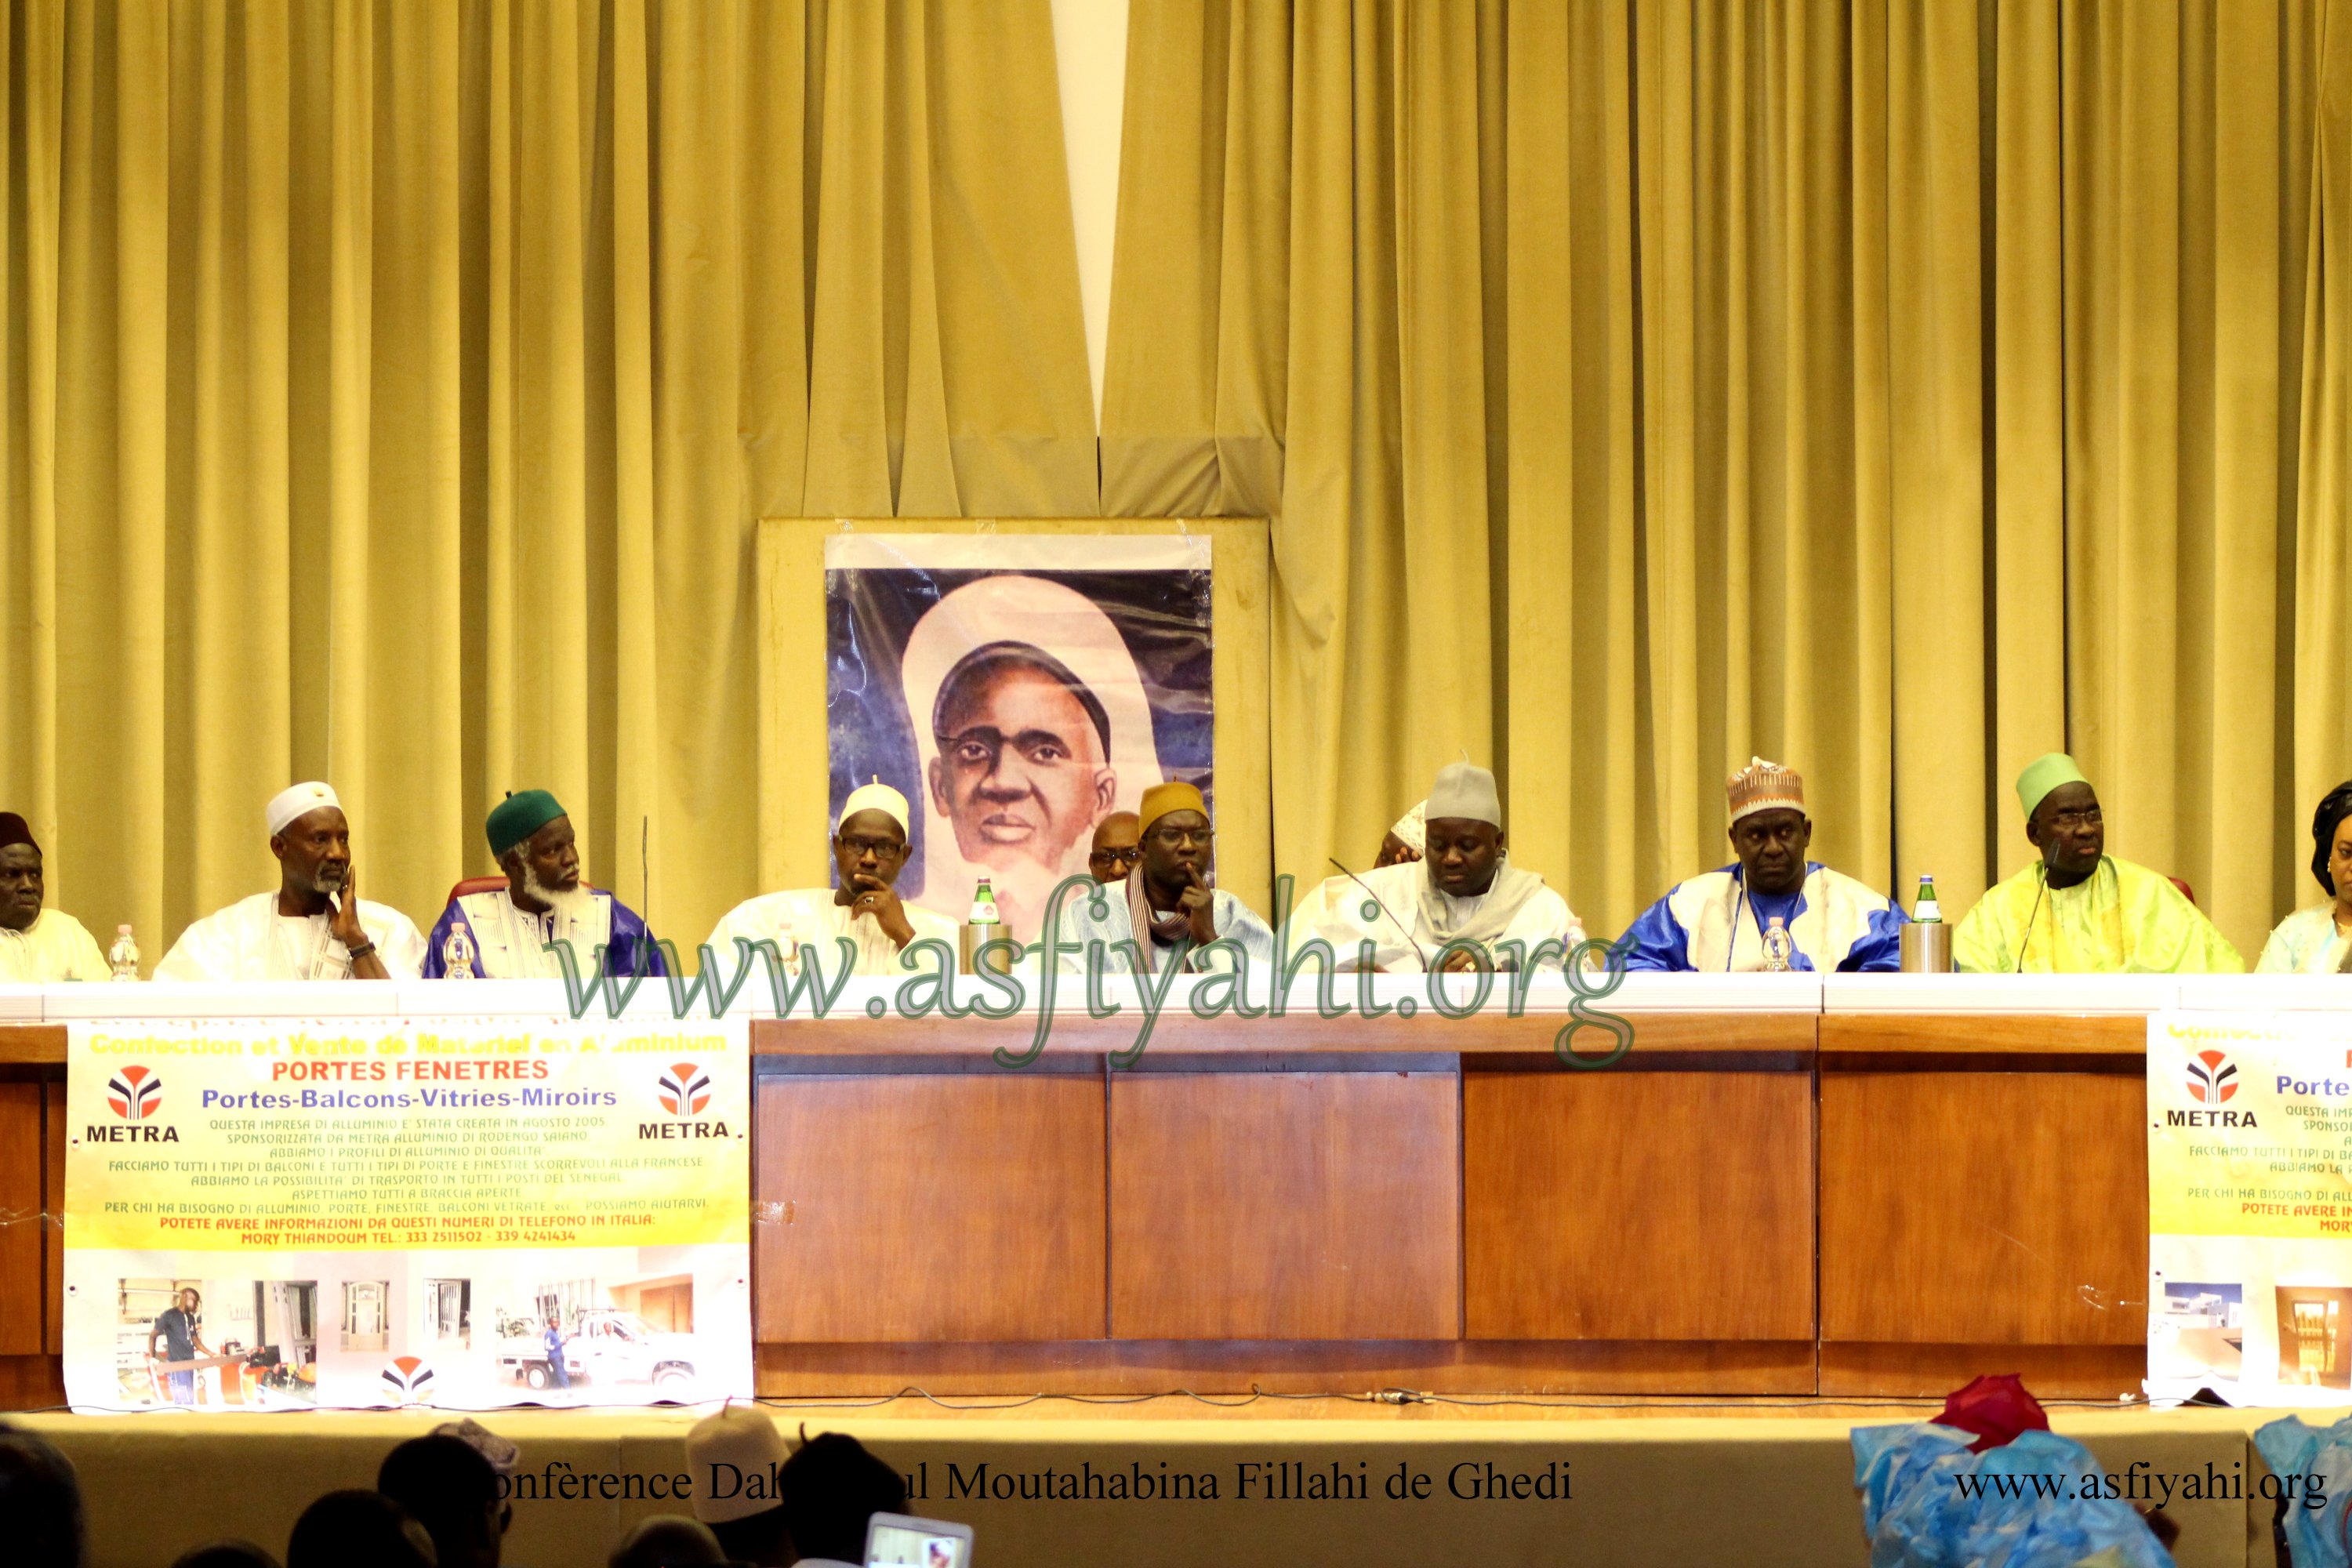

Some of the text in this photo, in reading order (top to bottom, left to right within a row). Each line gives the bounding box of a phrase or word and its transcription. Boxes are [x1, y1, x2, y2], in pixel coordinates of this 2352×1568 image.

[90, 1034, 242, 1054] Confection
[251, 1036, 279, 1054] et
[289, 1034, 366, 1054] Vente
[272, 1059, 549, 1082] PORTES FENETRES
[202, 1087, 617, 1109] Portes-Balcons-Vitries-Miroirs
[2167, 1109, 2258, 1128] METRA
[2286, 1106, 2328, 1117] QUESTA
[210, 1120, 255, 1131] QUESTA
[261, 1120, 310, 1131] IMPRESA
[316, 1120, 327, 1129] DI
[332, 1120, 397, 1129] ALLUMINIO
[416, 1119, 451, 1129] STATA
[456, 1118, 500, 1129] CREATA
[506, 1119, 517, 1127] IN
[523, 1118, 570, 1127] AGOSTO
[639, 1121, 729, 1140] METRA
[2303, 1120, 2352, 1132] SPONSO
[86, 1124, 180, 1144] METRA
[227, 1134, 321, 1145] SPONSORIZZATA
[328, 1134, 343, 1144] DA
[349, 1134, 389, 1144] METRA
[394, 1133, 457, 1144] ALLUMINIO
[463, 1133, 474, 1142] DI
[480, 1132, 538, 1142] RODENGO
[270, 1148, 325, 1159] ABBIAMO
[339, 1148, 384, 1158] PROFILI
[390, 1148, 401, 1157] DI
[405, 1147, 470, 1157] ALLUMINIO
[474, 1146, 485, 1156] DI
[2190, 1145, 2248, 1156] FACCIAMO
[2253, 1148, 2285, 1156] TUTTI
[2297, 1149, 2318, 1158] TIPI
[2323, 1149, 2334, 1160] DI
[109, 1160, 169, 1173] FACCIAMO
[174, 1161, 207, 1172] TUTTI
[220, 1162, 242, 1172] TIPI
[248, 1162, 260, 1171] DI
[265, 1162, 314, 1173] BALCONI
[320, 1162, 325, 1171] E
[332, 1162, 364, 1171] TUTTI
[377, 1161, 398, 1171] TIPI
[404, 1161, 414, 1171] DI
[419, 1160, 457, 1171] PORTE
[463, 1161, 468, 1170] E
[474, 1160, 527, 1171] FINESTRE
[534, 1160, 604, 1170] SCORREVOLI
[611, 1159, 638, 1167] ALLA
[2270, 1162, 2325, 1173] ABBIAMO
[2329, 1163, 2343, 1174] LA
[191, 1176, 249, 1187] ABBIAMO
[255, 1176, 268, 1186] LA
[352, 1176, 364, 1185] DI
[368, 1174, 438, 1186] TRASPORTO
[444, 1175, 455, 1184] IN
[460, 1174, 492, 1184] TUTTI
[506, 1174, 539, 1183] POSTI
[545, 1174, 564, 1183] DEL
[292, 1189, 367, 1200] ASPETTIAMO
[372, 1189, 404, 1200] TUTTI
[408, 1189, 416, 1200] A
[421, 1189, 471, 1199] BRACCIA
[2188, 1188, 2209, 1199] PER
[2214, 1189, 2233, 1198] CHI
[2239, 1189, 2255, 1200] HA
[2260, 1189, 2312, 1200] BISOGNO
[2316, 1189, 2328, 1201] DI
[104, 1201, 129, 1214] PER
[132, 1202, 152, 1214] CHI
[158, 1202, 174, 1214] HA
[180, 1203, 234, 1214] BISOGNO
[239, 1204, 251, 1214] DI
[439, 1203, 488, 1213] BALCONI
[586, 1200, 646, 1210] POSSIAMO
[2241, 1203, 2288, 1216] POTETE
[2293, 1205, 2337, 1218] AVERE
[160, 1214, 655, 1232] POTETE AVERE INFORMAZIONI DA QUESTI NUMERI DI TELEFONO IN ITALIA:
[241, 1232, 280, 1246] MORY
[284, 1232, 367, 1245] THIANDOUM
[406, 1232, 427, 1243] 333
[433, 1231, 482, 1243] 2511502
[495, 1230, 519, 1242] 339
[524, 1231, 575, 1242] 4241434
